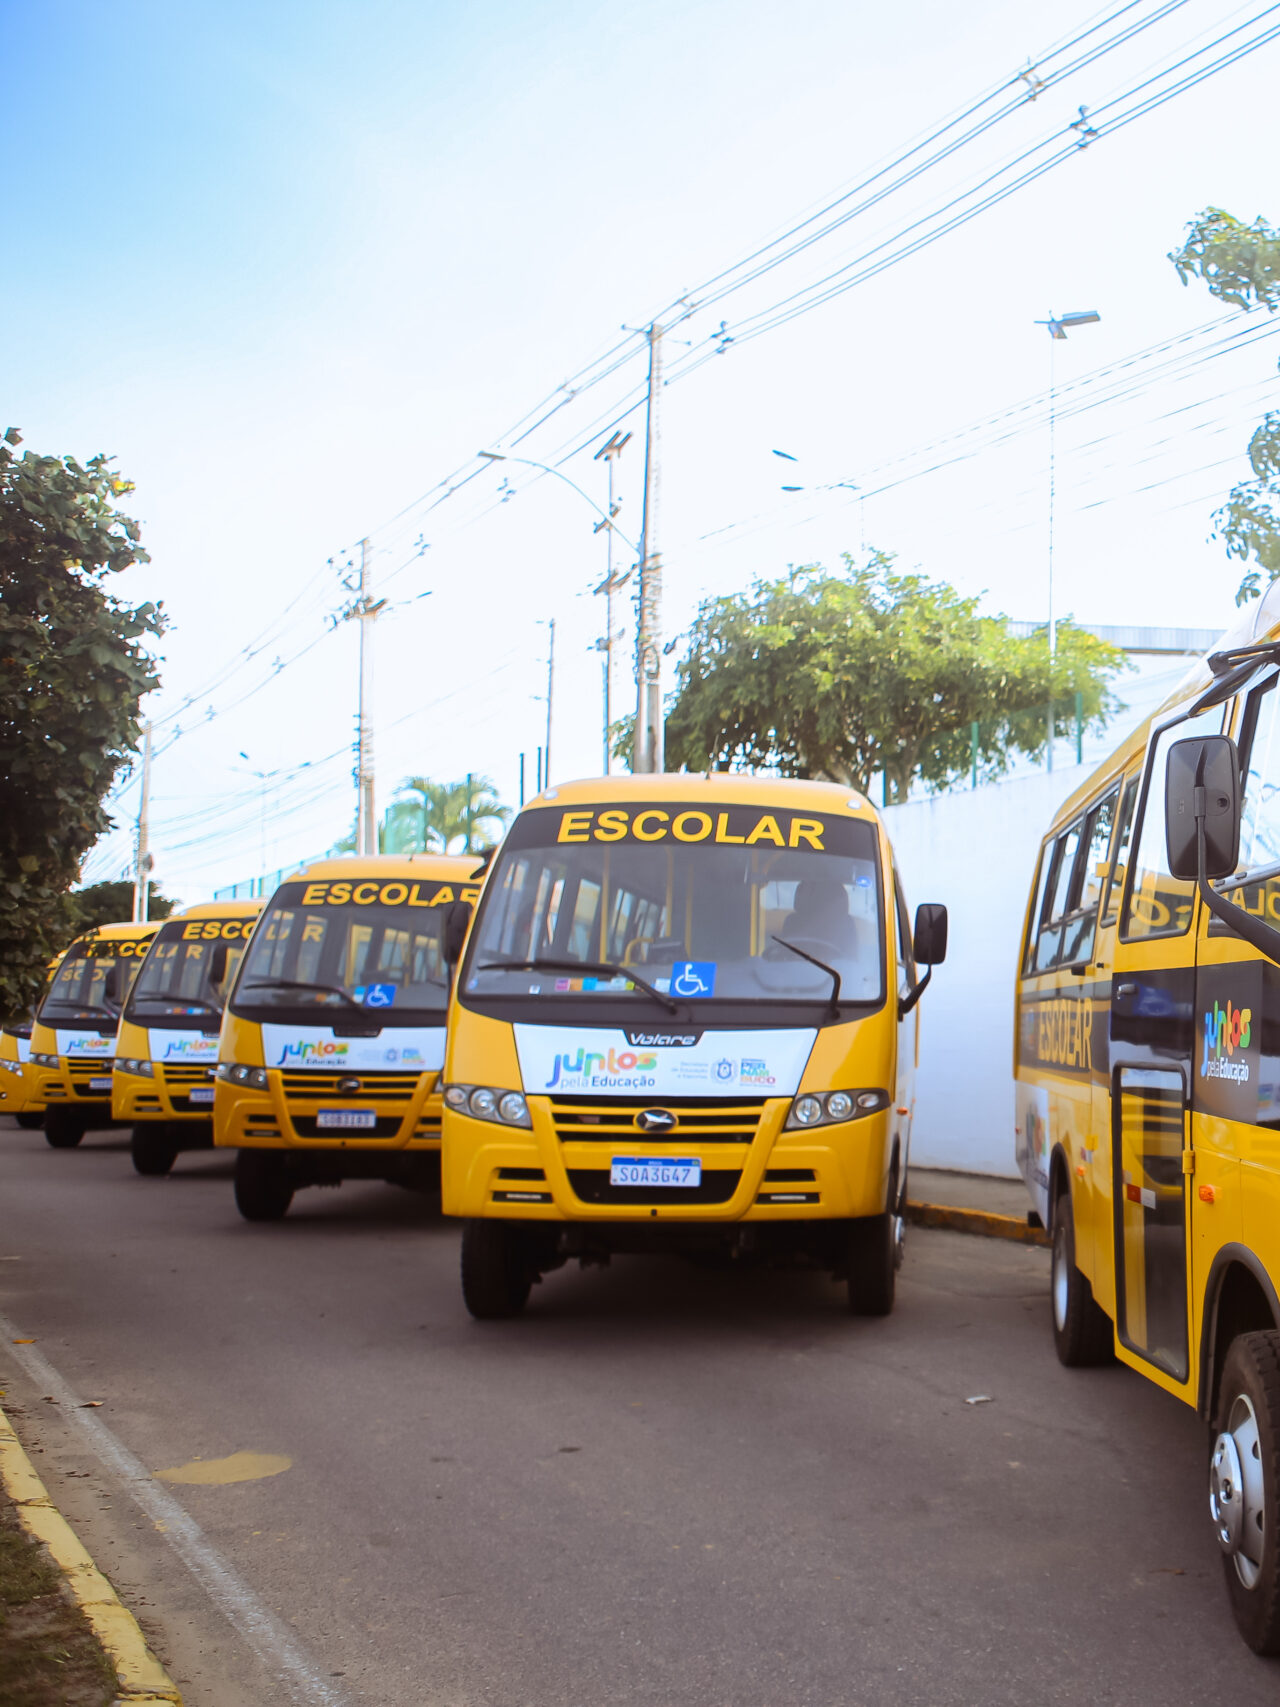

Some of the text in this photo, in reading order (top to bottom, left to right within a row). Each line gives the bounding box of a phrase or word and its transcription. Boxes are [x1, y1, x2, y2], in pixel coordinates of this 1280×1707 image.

[557, 810, 825, 850] ESCOLAR
[631, 1033, 696, 1046] Volare
[1201, 999, 1251, 1078] juntos
[545, 1047, 658, 1088] juntos
[592, 1075, 655, 1088] Educação
[620, 1167, 691, 1183] SOA3G47
